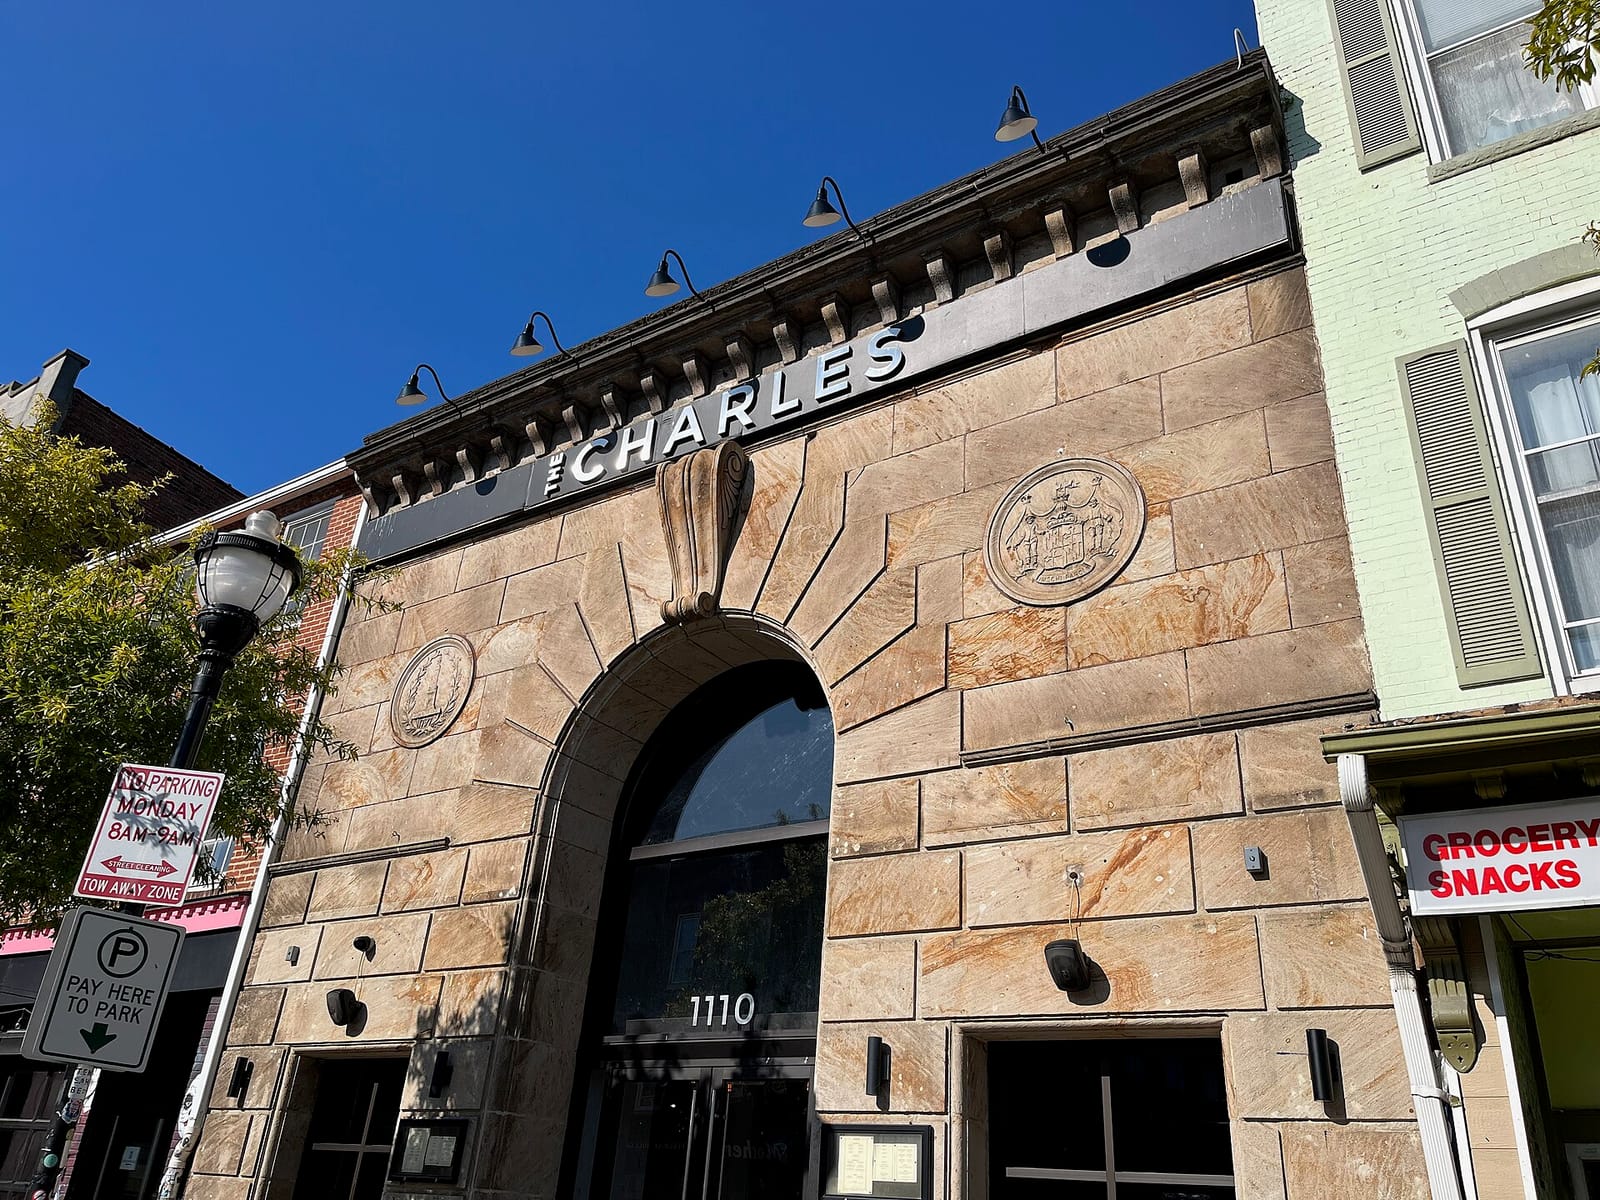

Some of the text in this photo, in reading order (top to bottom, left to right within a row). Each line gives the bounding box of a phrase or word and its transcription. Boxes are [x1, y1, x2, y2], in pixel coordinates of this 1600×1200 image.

[544, 327, 906, 497] THE CHARLES
[118, 771, 215, 798] NO PARKING
[117, 796, 203, 820] MONDAY
[108, 822, 195, 847] 8AM-9AM
[1422, 818, 1600, 862] GROCERY
[107, 860, 171, 873] STREET CLEANING
[1428, 859, 1582, 899] SNACKS
[82, 878, 182, 900] TOW AWAY ZONE
[108, 936, 140, 968] P
[66, 975, 155, 1006] PAY HERE
[67, 995, 144, 1024] TO PARK
[690, 992, 755, 1027] 1110
